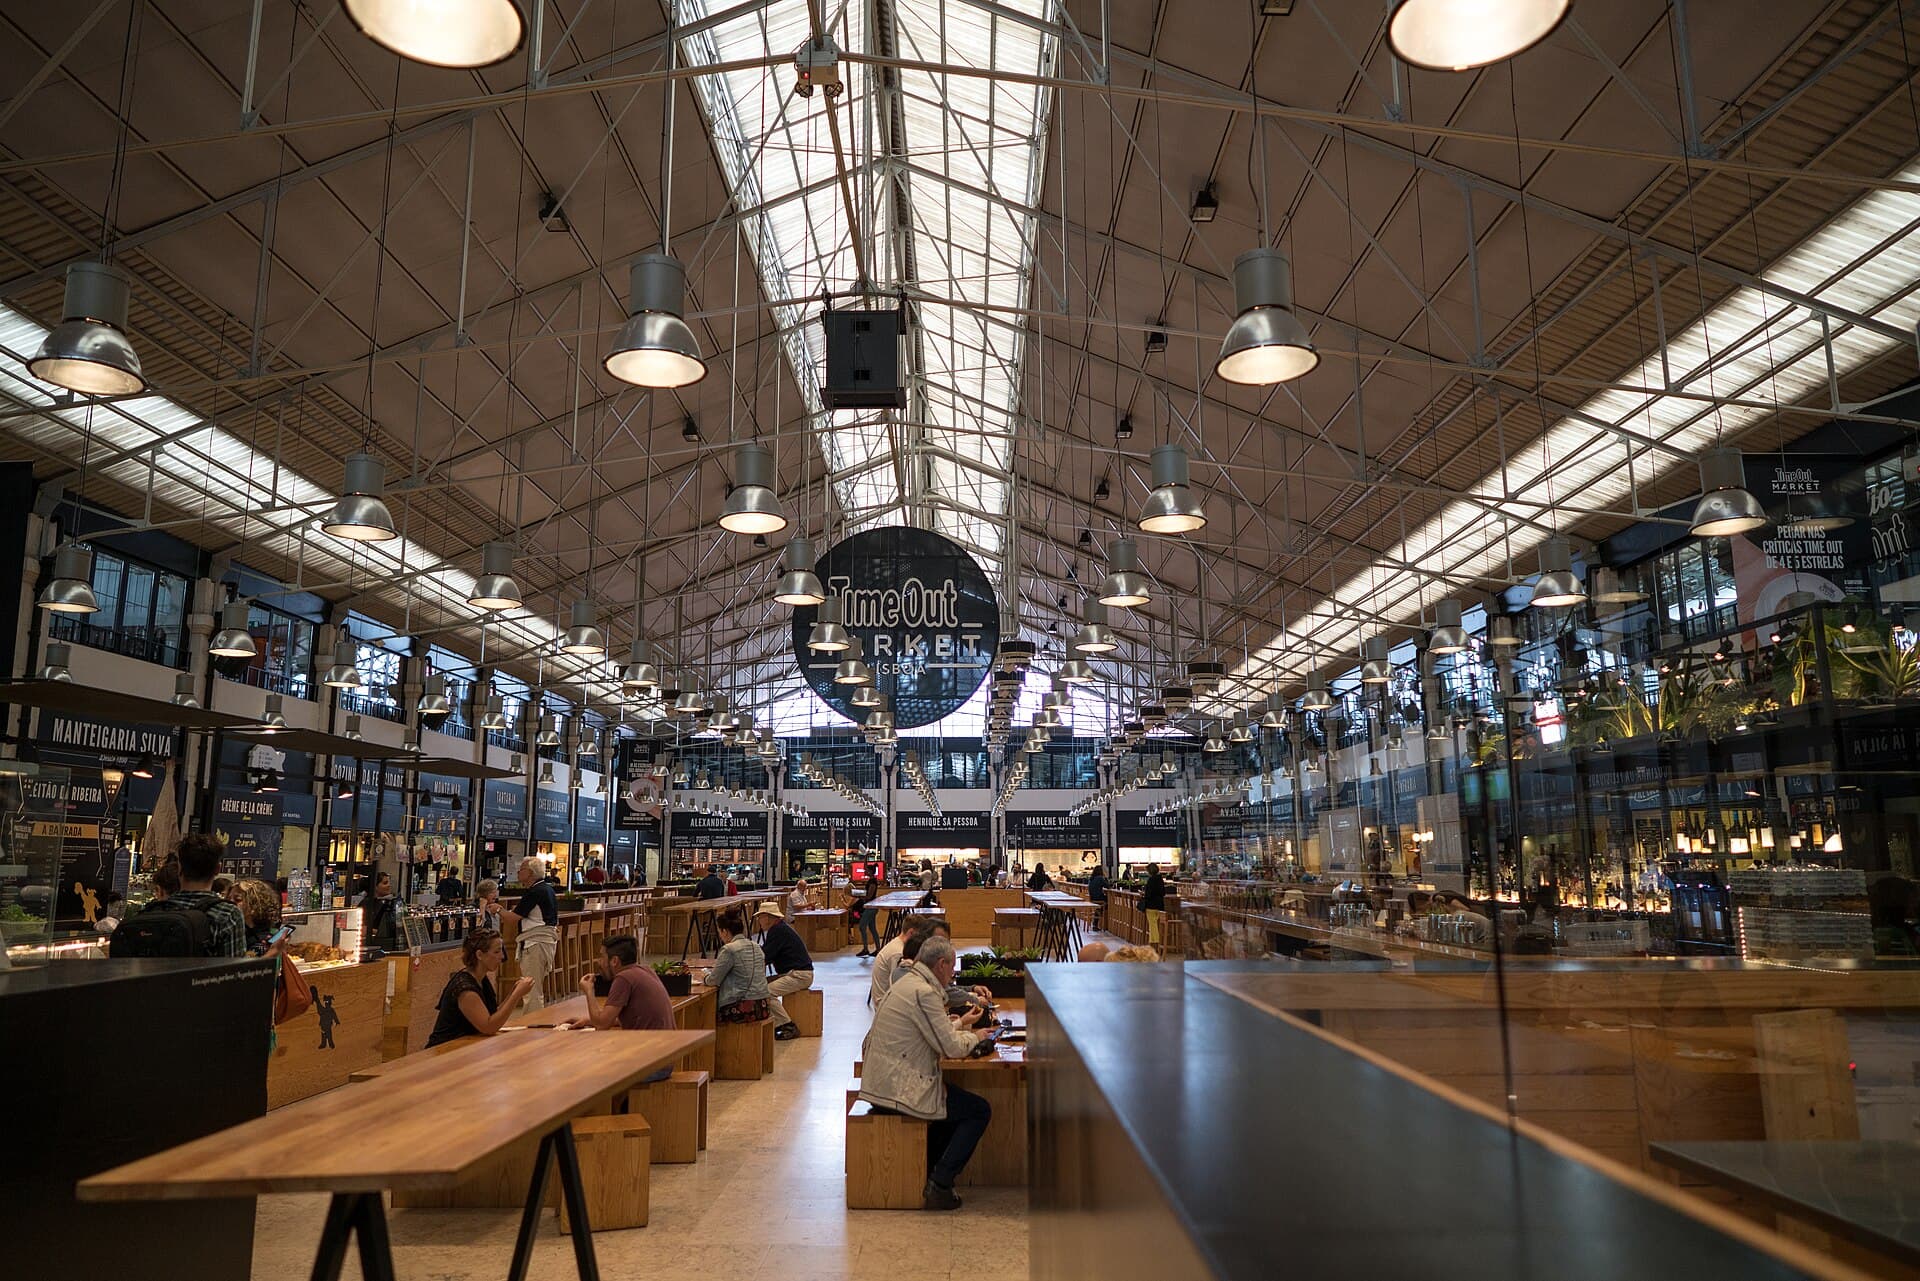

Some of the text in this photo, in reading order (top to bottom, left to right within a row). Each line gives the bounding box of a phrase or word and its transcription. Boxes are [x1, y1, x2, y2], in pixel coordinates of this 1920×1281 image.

[1772, 483, 1820, 491] MARKET
[1807, 525, 1826, 539] NAS
[1762, 538, 1844, 554] CRÍTICAS TIME OUT
[1766, 555, 1778, 569] DE
[1779, 555, 1786, 569] 4
[1787, 555, 1793, 569] E
[1802, 555, 1845, 569] ESTRELAS
[902, 577, 958, 628] Out
[810, 634, 982, 656] RKET
[52, 718, 171, 757] MANTEIGARIA SILVA
[29, 780, 57, 799] EITÃO
[71, 785, 102, 803] RIBEIRA
[240, 800, 248, 813] DE
[248, 801, 255, 814] LA
[690, 817, 749, 827] ALEXANDRE SILVA
[792, 817, 817, 827] MIGUEL
[851, 817, 871, 827] SILVA
[908, 817, 941, 827] HENRIQUE
[953, 817, 978, 826] PESSOA
[1026, 816, 1081, 826] MARLENE VIEIRA
[1138, 816, 1163, 825] MIGUEL
